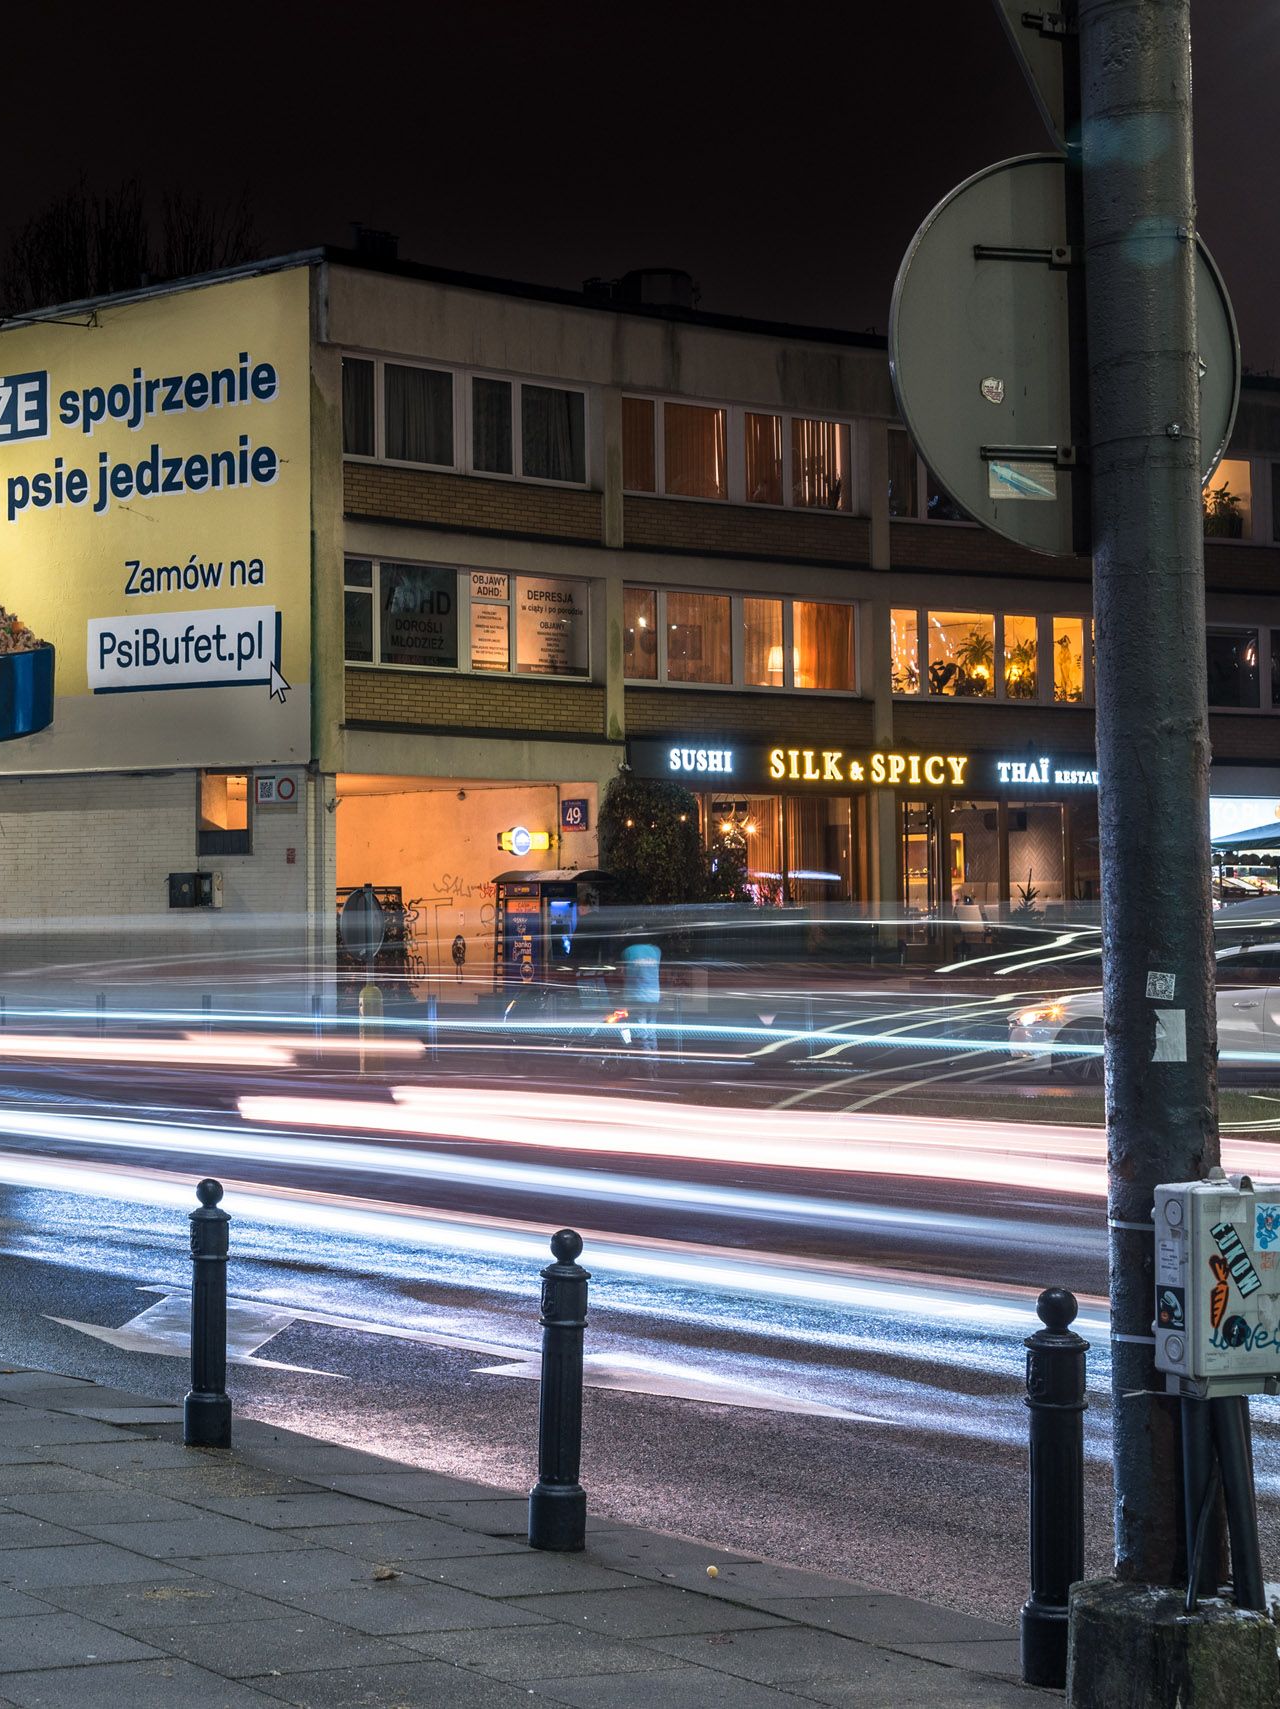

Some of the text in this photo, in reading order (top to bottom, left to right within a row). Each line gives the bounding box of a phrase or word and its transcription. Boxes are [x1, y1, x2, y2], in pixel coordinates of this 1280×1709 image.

[59, 353, 277, 432] spojrzenie
[7, 458, 88, 521] psie
[95, 436, 277, 512] jedzenie
[125, 556, 264, 596] Zamów na
[472, 574, 506, 586] OBJAWY
[527, 590, 574, 604] DEPRESJA
[395, 617, 443, 634] DOROŚLI
[98, 620, 264, 672] PsiBufet.pl
[390, 634, 445, 650] MŁODZIEŻ
[669, 748, 733, 773] SUSHI
[770, 748, 844, 781] SILK
[850, 760, 864, 781] &
[870, 753, 969, 785] SPICY
[997, 757, 1050, 783] THAÏ
[566, 807, 581, 824] 49
